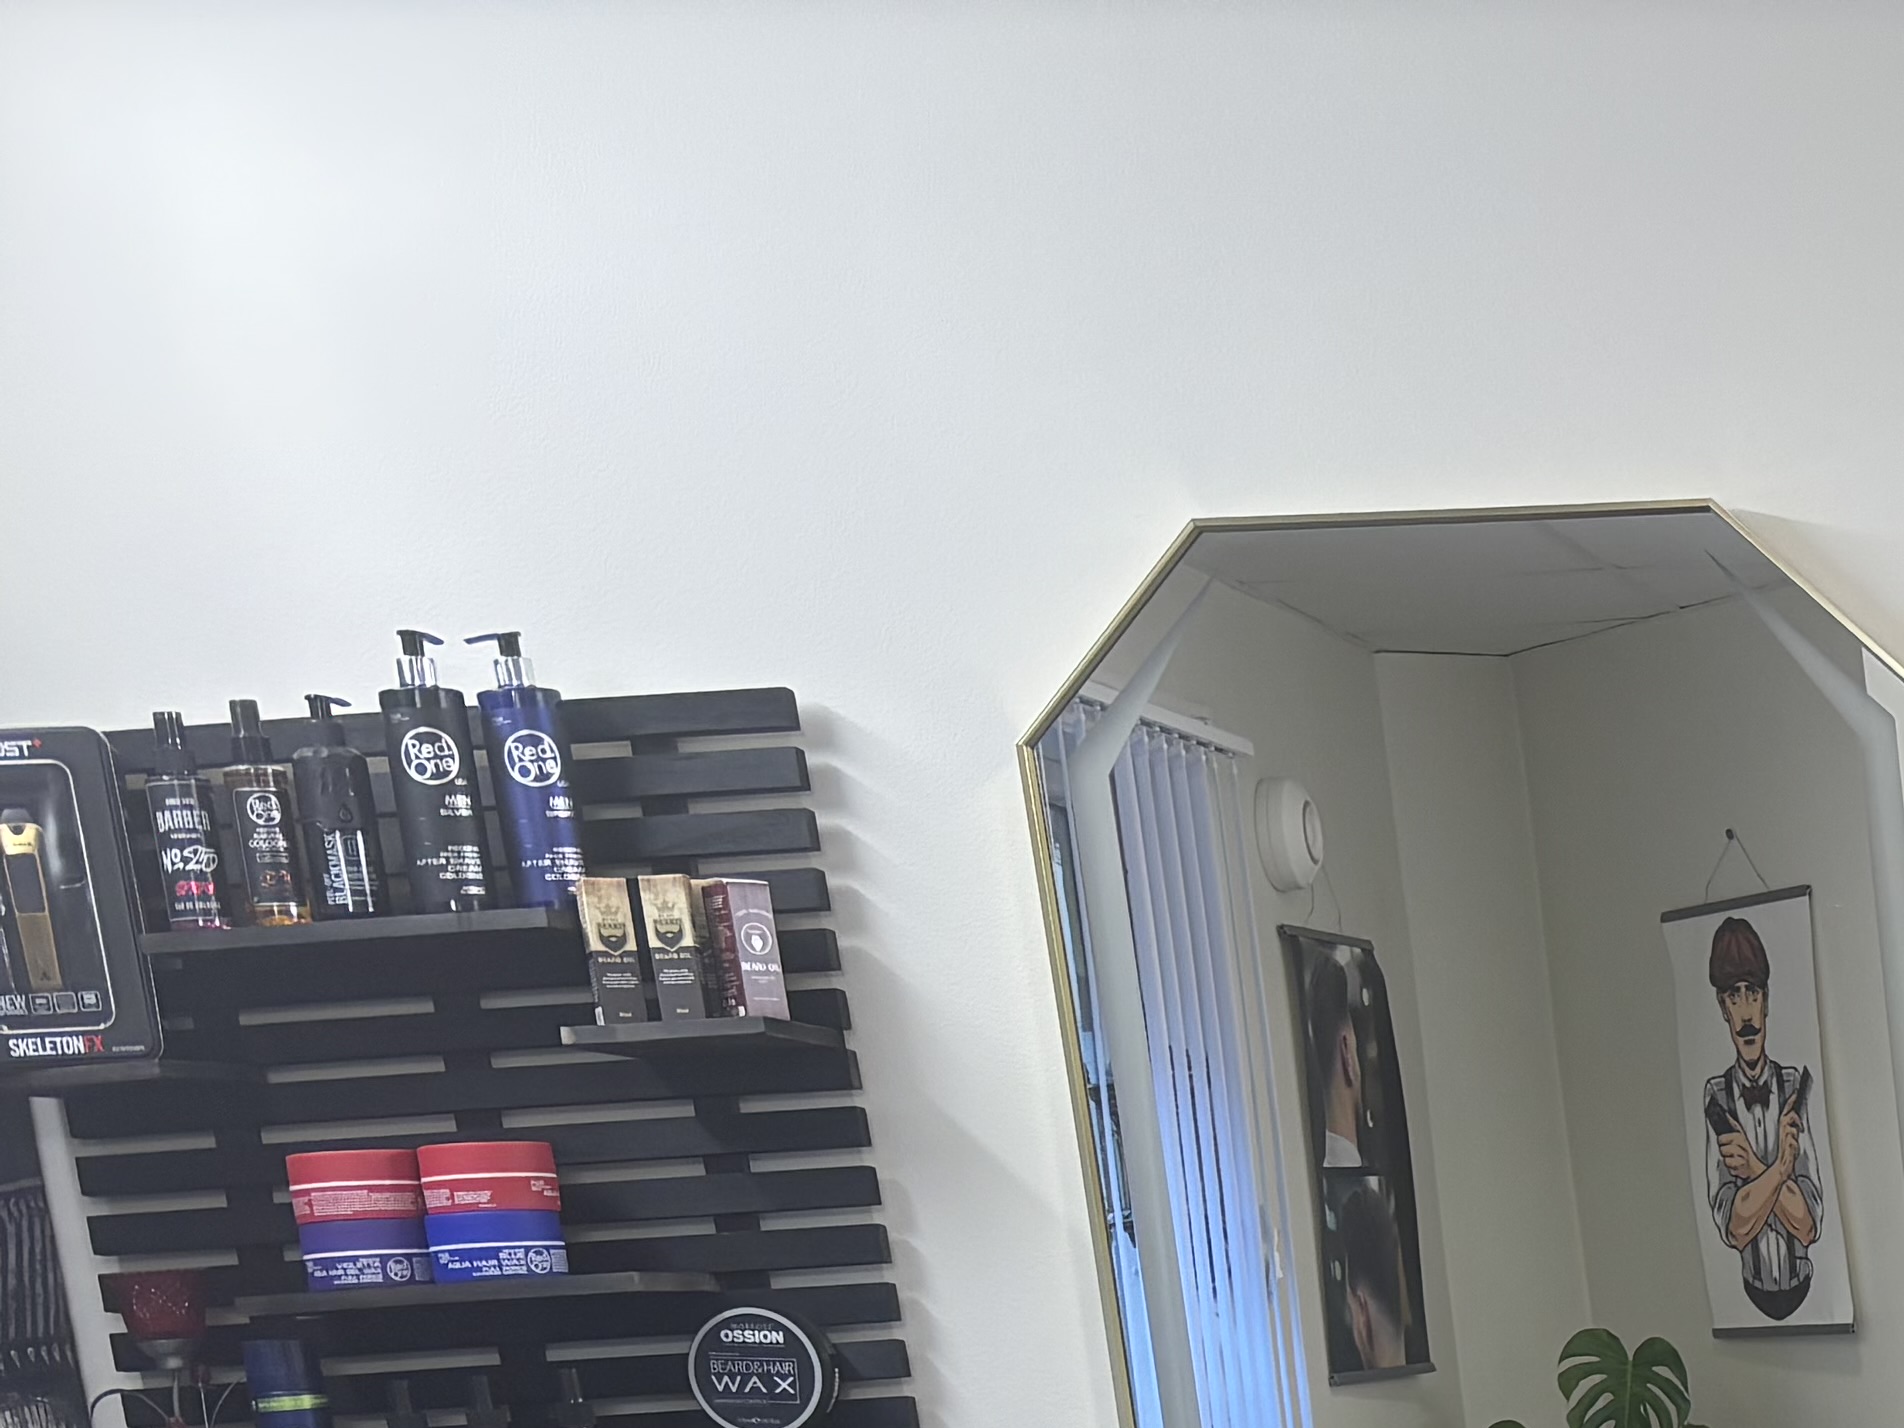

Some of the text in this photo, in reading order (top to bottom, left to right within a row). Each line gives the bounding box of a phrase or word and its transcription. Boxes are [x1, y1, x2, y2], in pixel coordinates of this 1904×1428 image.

[407, 738, 452, 760] Red
[510, 741, 554, 762] Red
[411, 757, 455, 779] One
[514, 760, 557, 781] One
[445, 794, 471, 807] MEN
[155, 809, 211, 833] BARBER
[323, 833, 349, 904] BLACKMASK
[8, 1035, 104, 1057] SKELETONFX
[720, 1329, 784, 1344] OSSION
[711, 1375, 795, 1394] WAX
